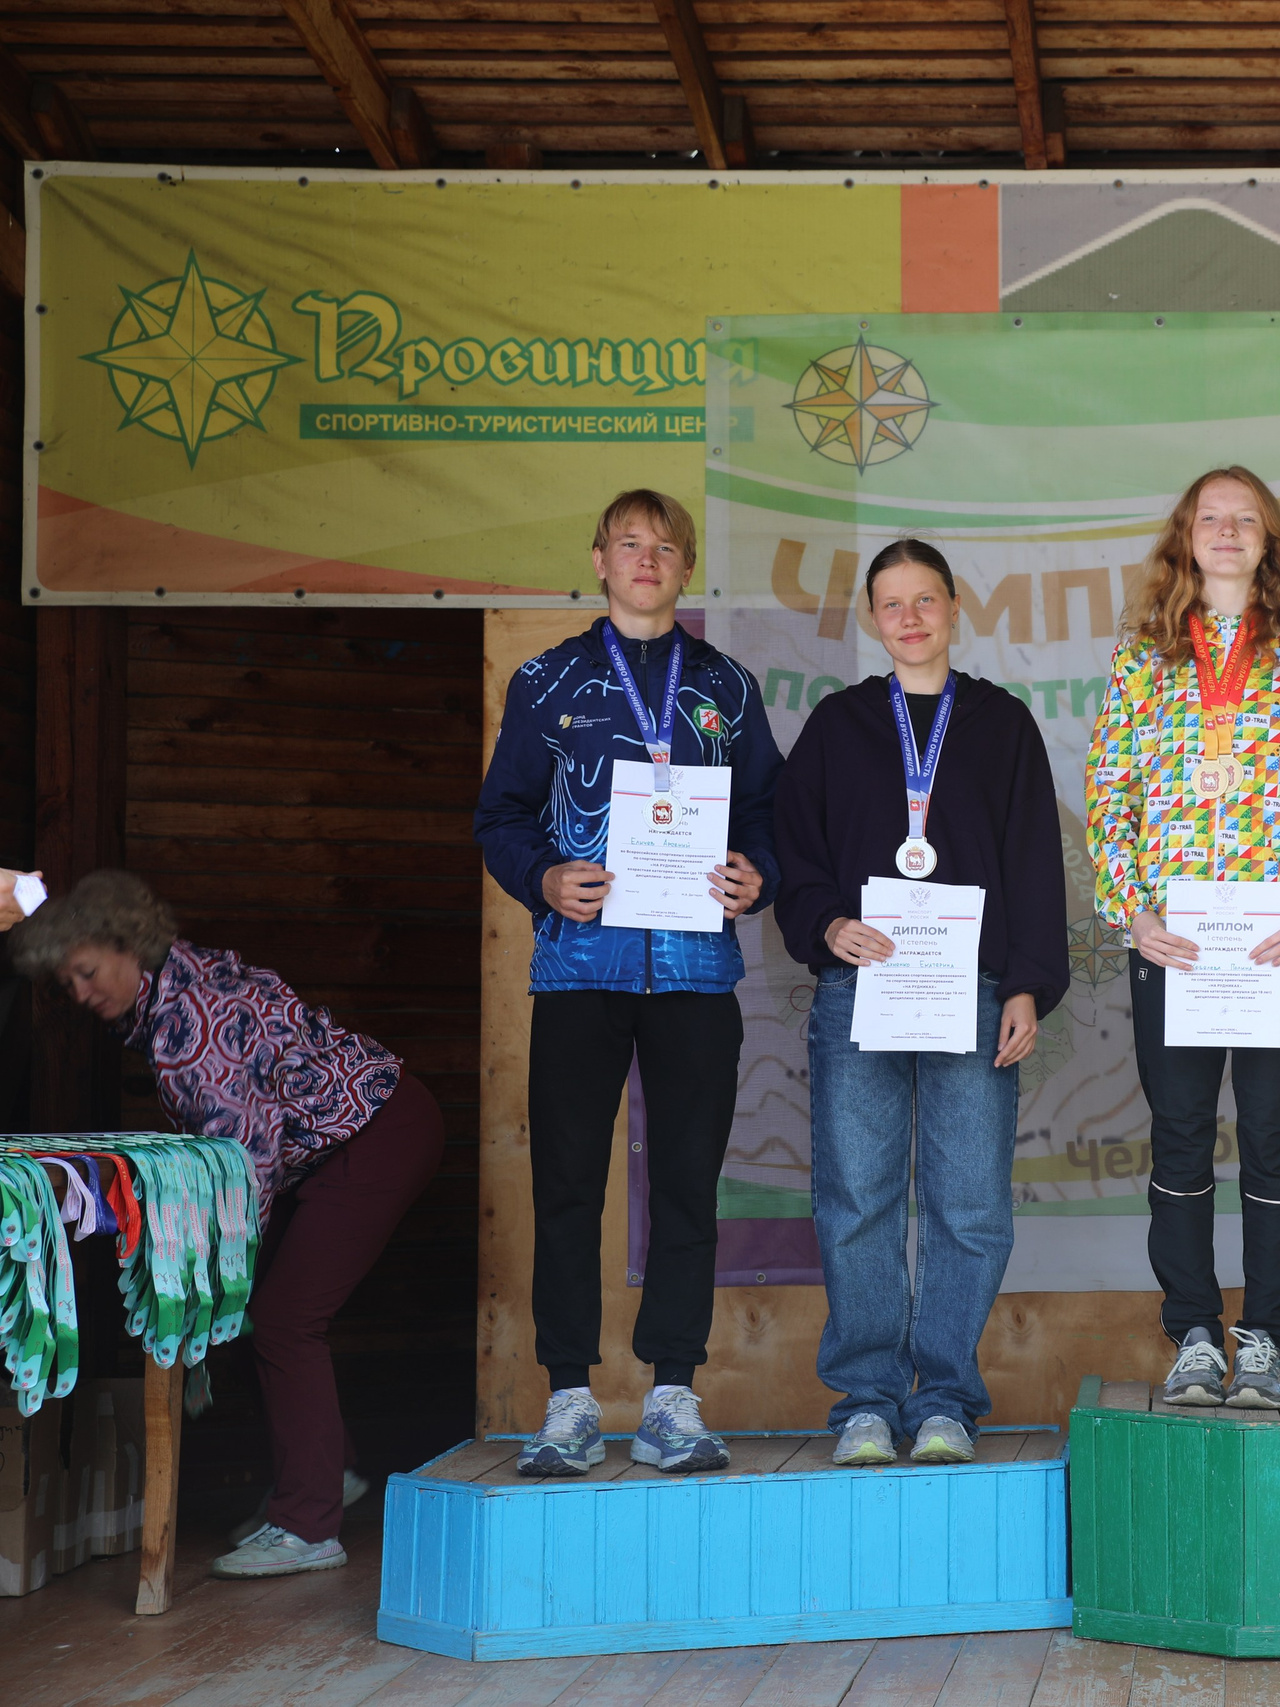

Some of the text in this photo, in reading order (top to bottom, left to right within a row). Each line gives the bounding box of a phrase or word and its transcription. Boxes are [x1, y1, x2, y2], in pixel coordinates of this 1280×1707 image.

[315, 412, 658, 435] СПОРТИВНО-ТУРИСТИЧЕСКИЙ
[1192, 616, 1202, 643] ОБЛАСТ
[1230, 625, 1248, 662] ЯБИНСКАЯ
[610, 644, 649, 731] ЧЕЛЯБИНСКАЯ ОБЛАСТЬ
[662, 643, 682, 729] ЧЕЛЯБИНСКАЯ ОБЛАСТЬ
[894, 692, 914, 777] ЧЕЛЯБИНСКАЯ ОБЛАСТЬ
[923, 694, 950, 778] ЧЕЛЯБИНСКАЯ ОБЛАСТЬ
[892, 926, 948, 936] ДИПЛОМ
[1197, 922, 1253, 932] ДИПЛОМ
